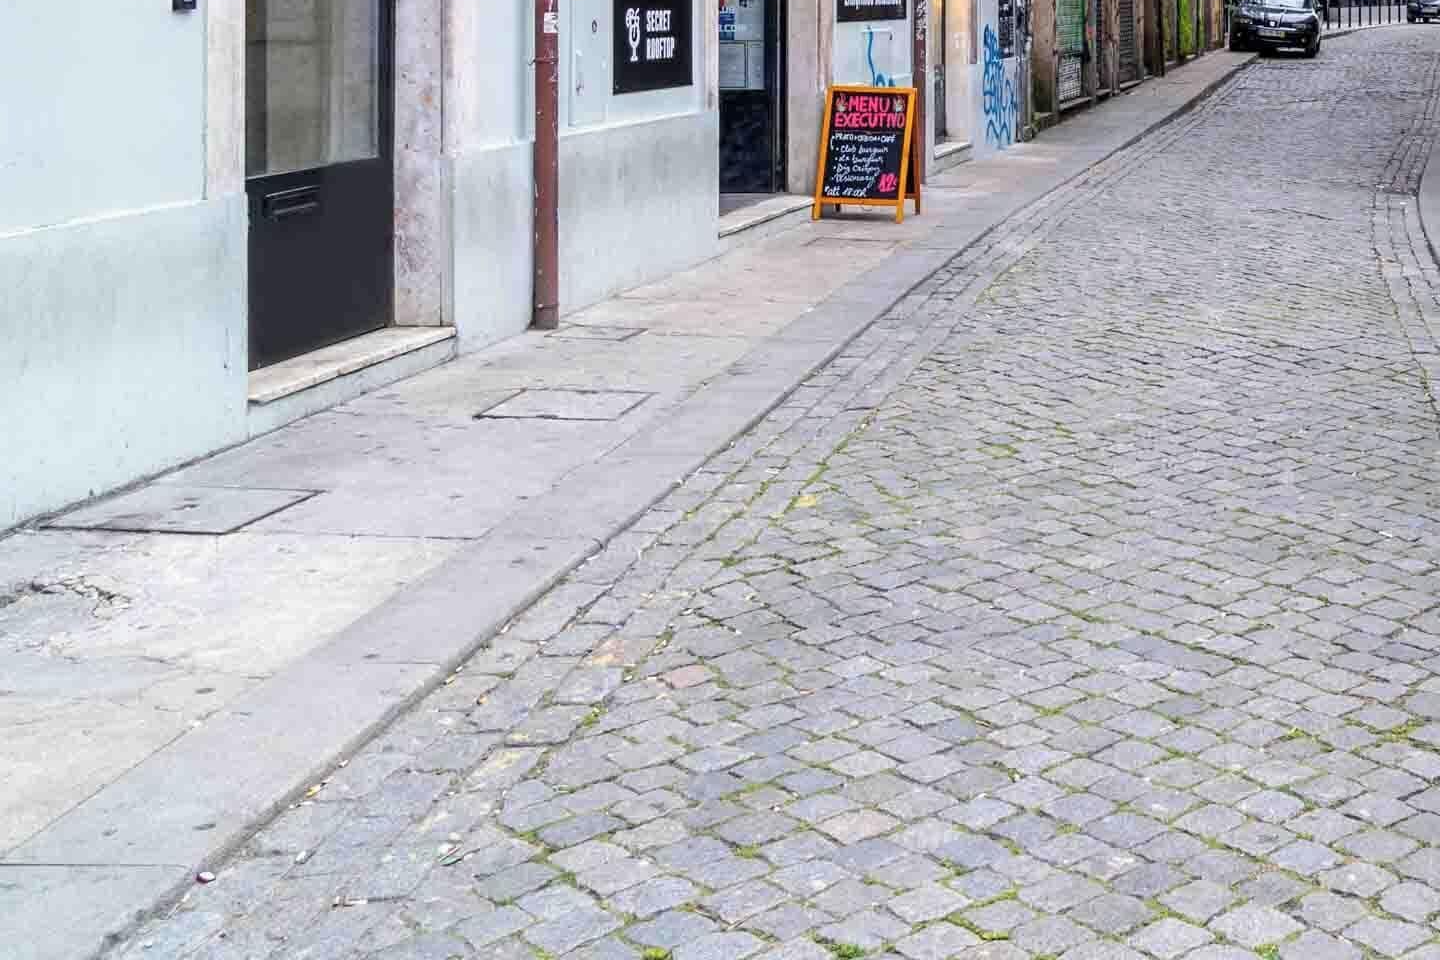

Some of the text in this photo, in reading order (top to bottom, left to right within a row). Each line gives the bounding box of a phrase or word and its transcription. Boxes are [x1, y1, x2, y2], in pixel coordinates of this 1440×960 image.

[646, 9, 671, 32] SECRET
[646, 36, 675, 60] ROOFTOP
[848, 95, 890, 112] MENU
[834, 112, 905, 128] EXECUTIVO
